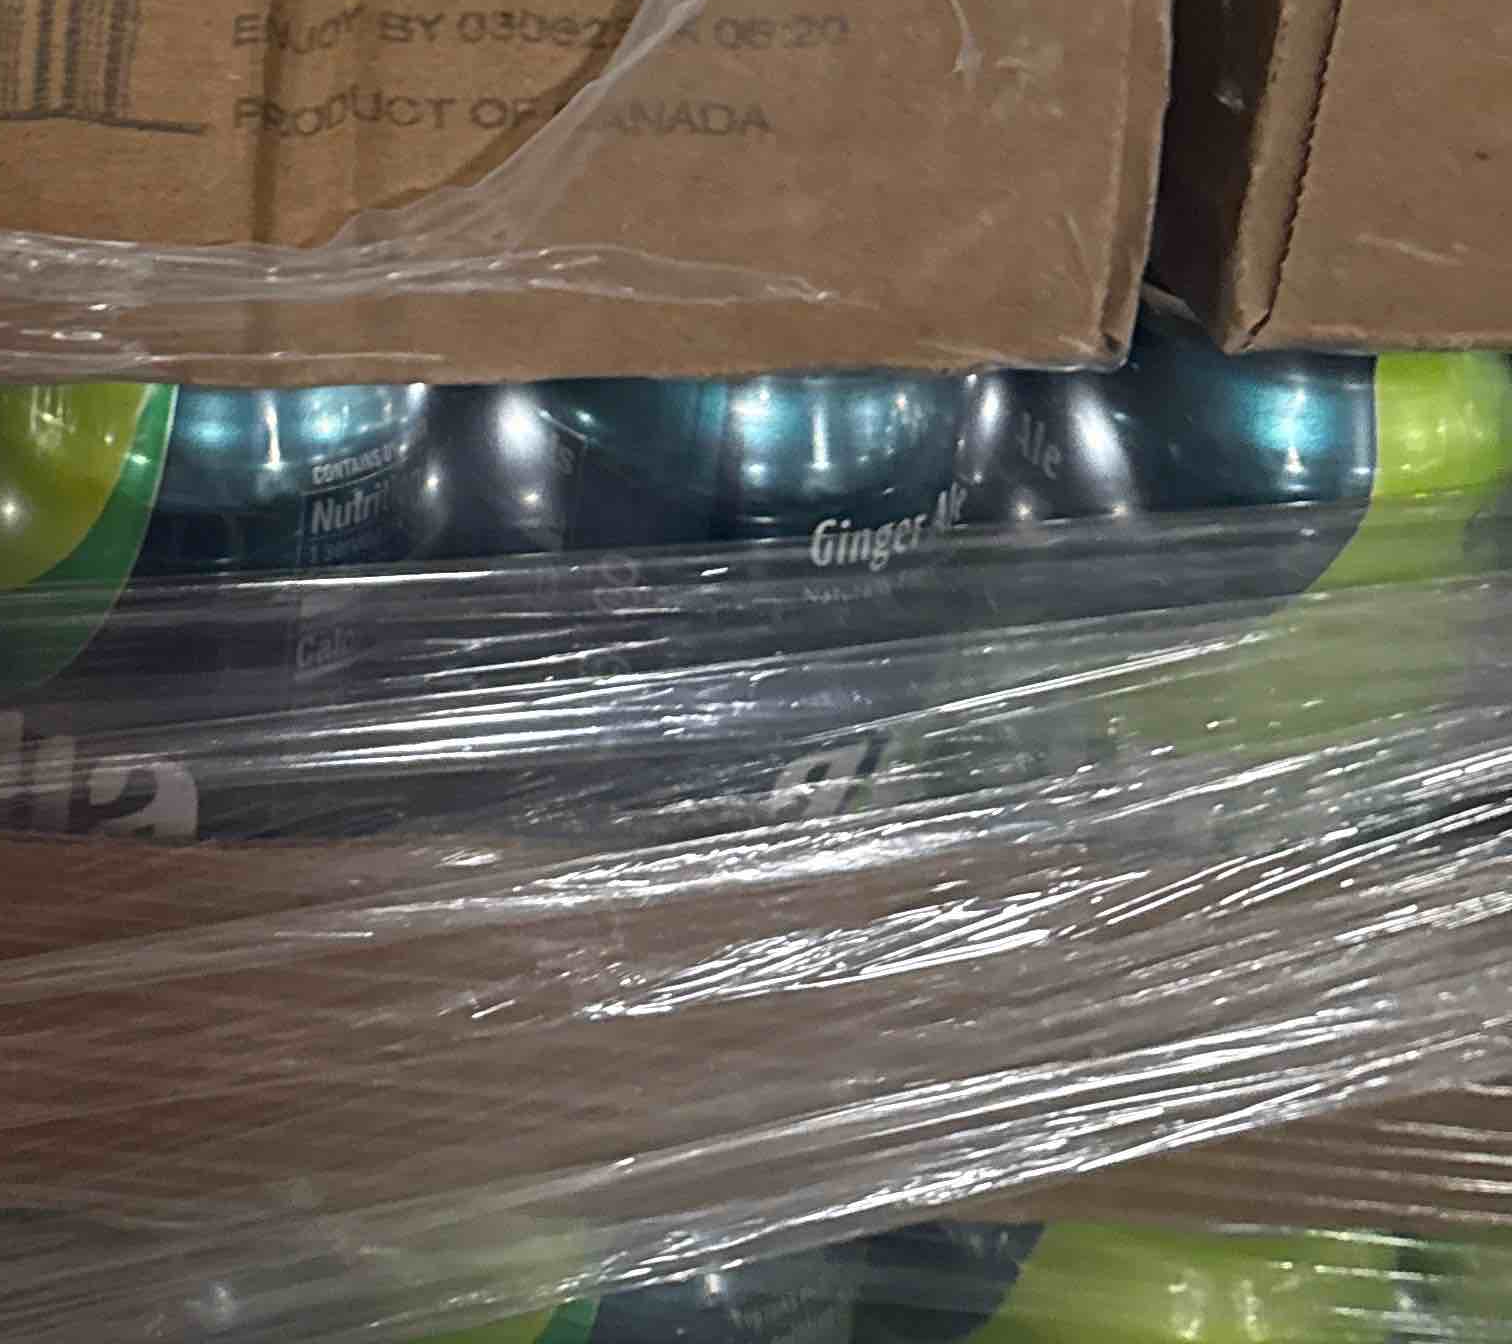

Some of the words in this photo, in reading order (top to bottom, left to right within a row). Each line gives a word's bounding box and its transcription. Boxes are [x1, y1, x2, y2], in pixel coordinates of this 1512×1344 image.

[377, 14, 445, 44] BY
[232, 82, 456, 138] PRODUCT
[469, 95, 538, 130] OF
[573, 95, 774, 138] ANADA
[810, 514, 928, 573] Ginger
